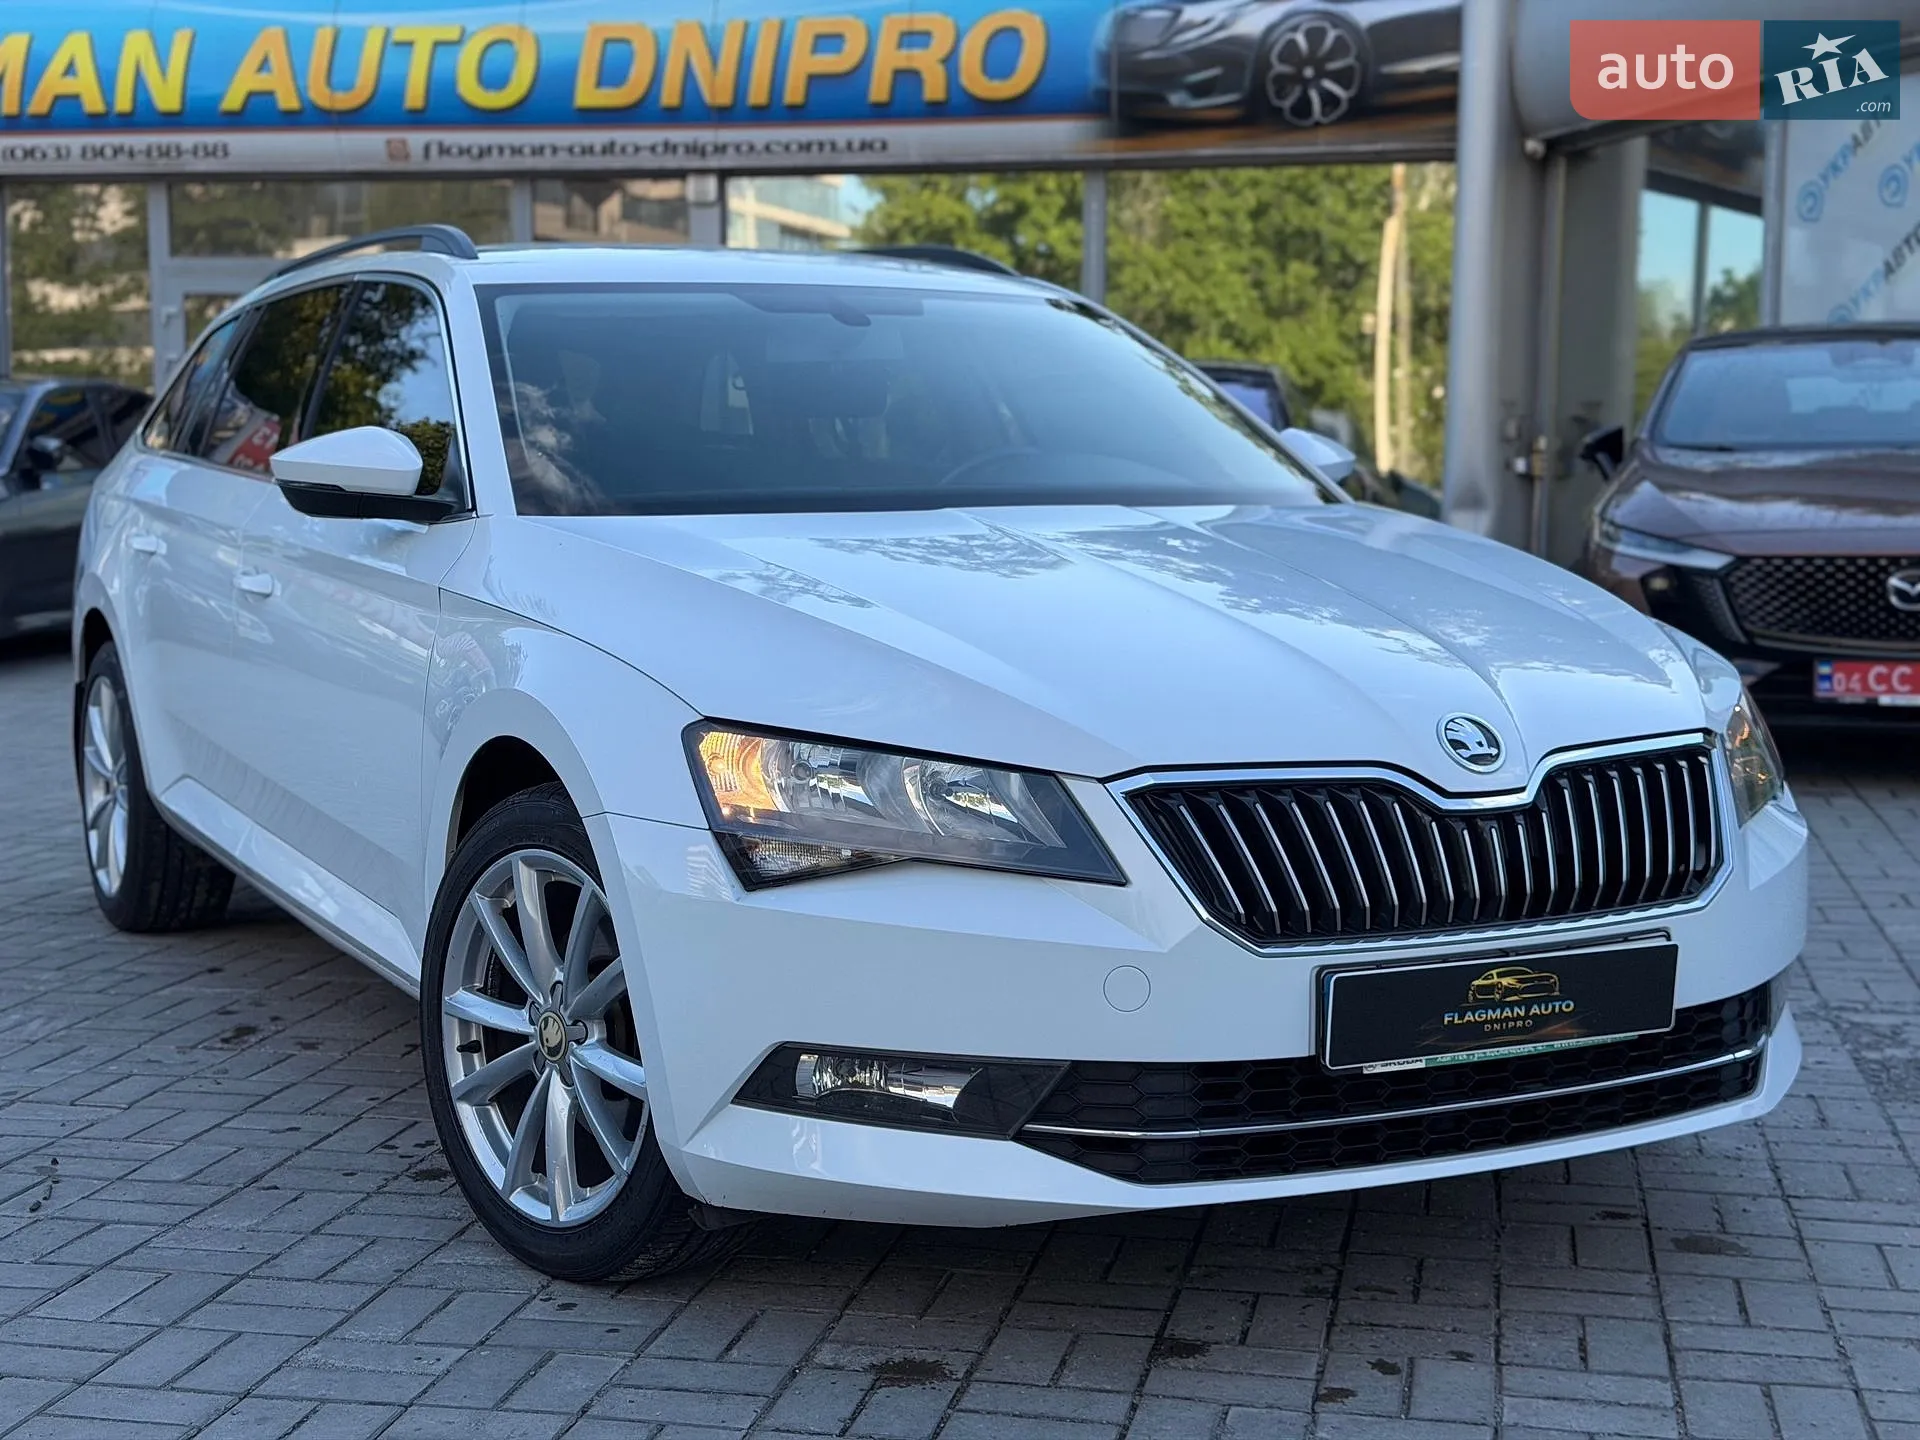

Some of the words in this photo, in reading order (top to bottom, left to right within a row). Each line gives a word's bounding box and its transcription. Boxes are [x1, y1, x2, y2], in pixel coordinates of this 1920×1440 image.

[219, 24, 540, 115] AUTO
[573, 9, 1050, 110] DNIPRO
[1, 144, 71, 162] (063)
[421, 136, 889, 163] flagman-auto-dnipro.com.ua
[1443, 1004, 1527, 1026] FLAGMAN
[1529, 998, 1575, 1022] AUTO
[1483, 1019, 1533, 1032] DNIPRO
